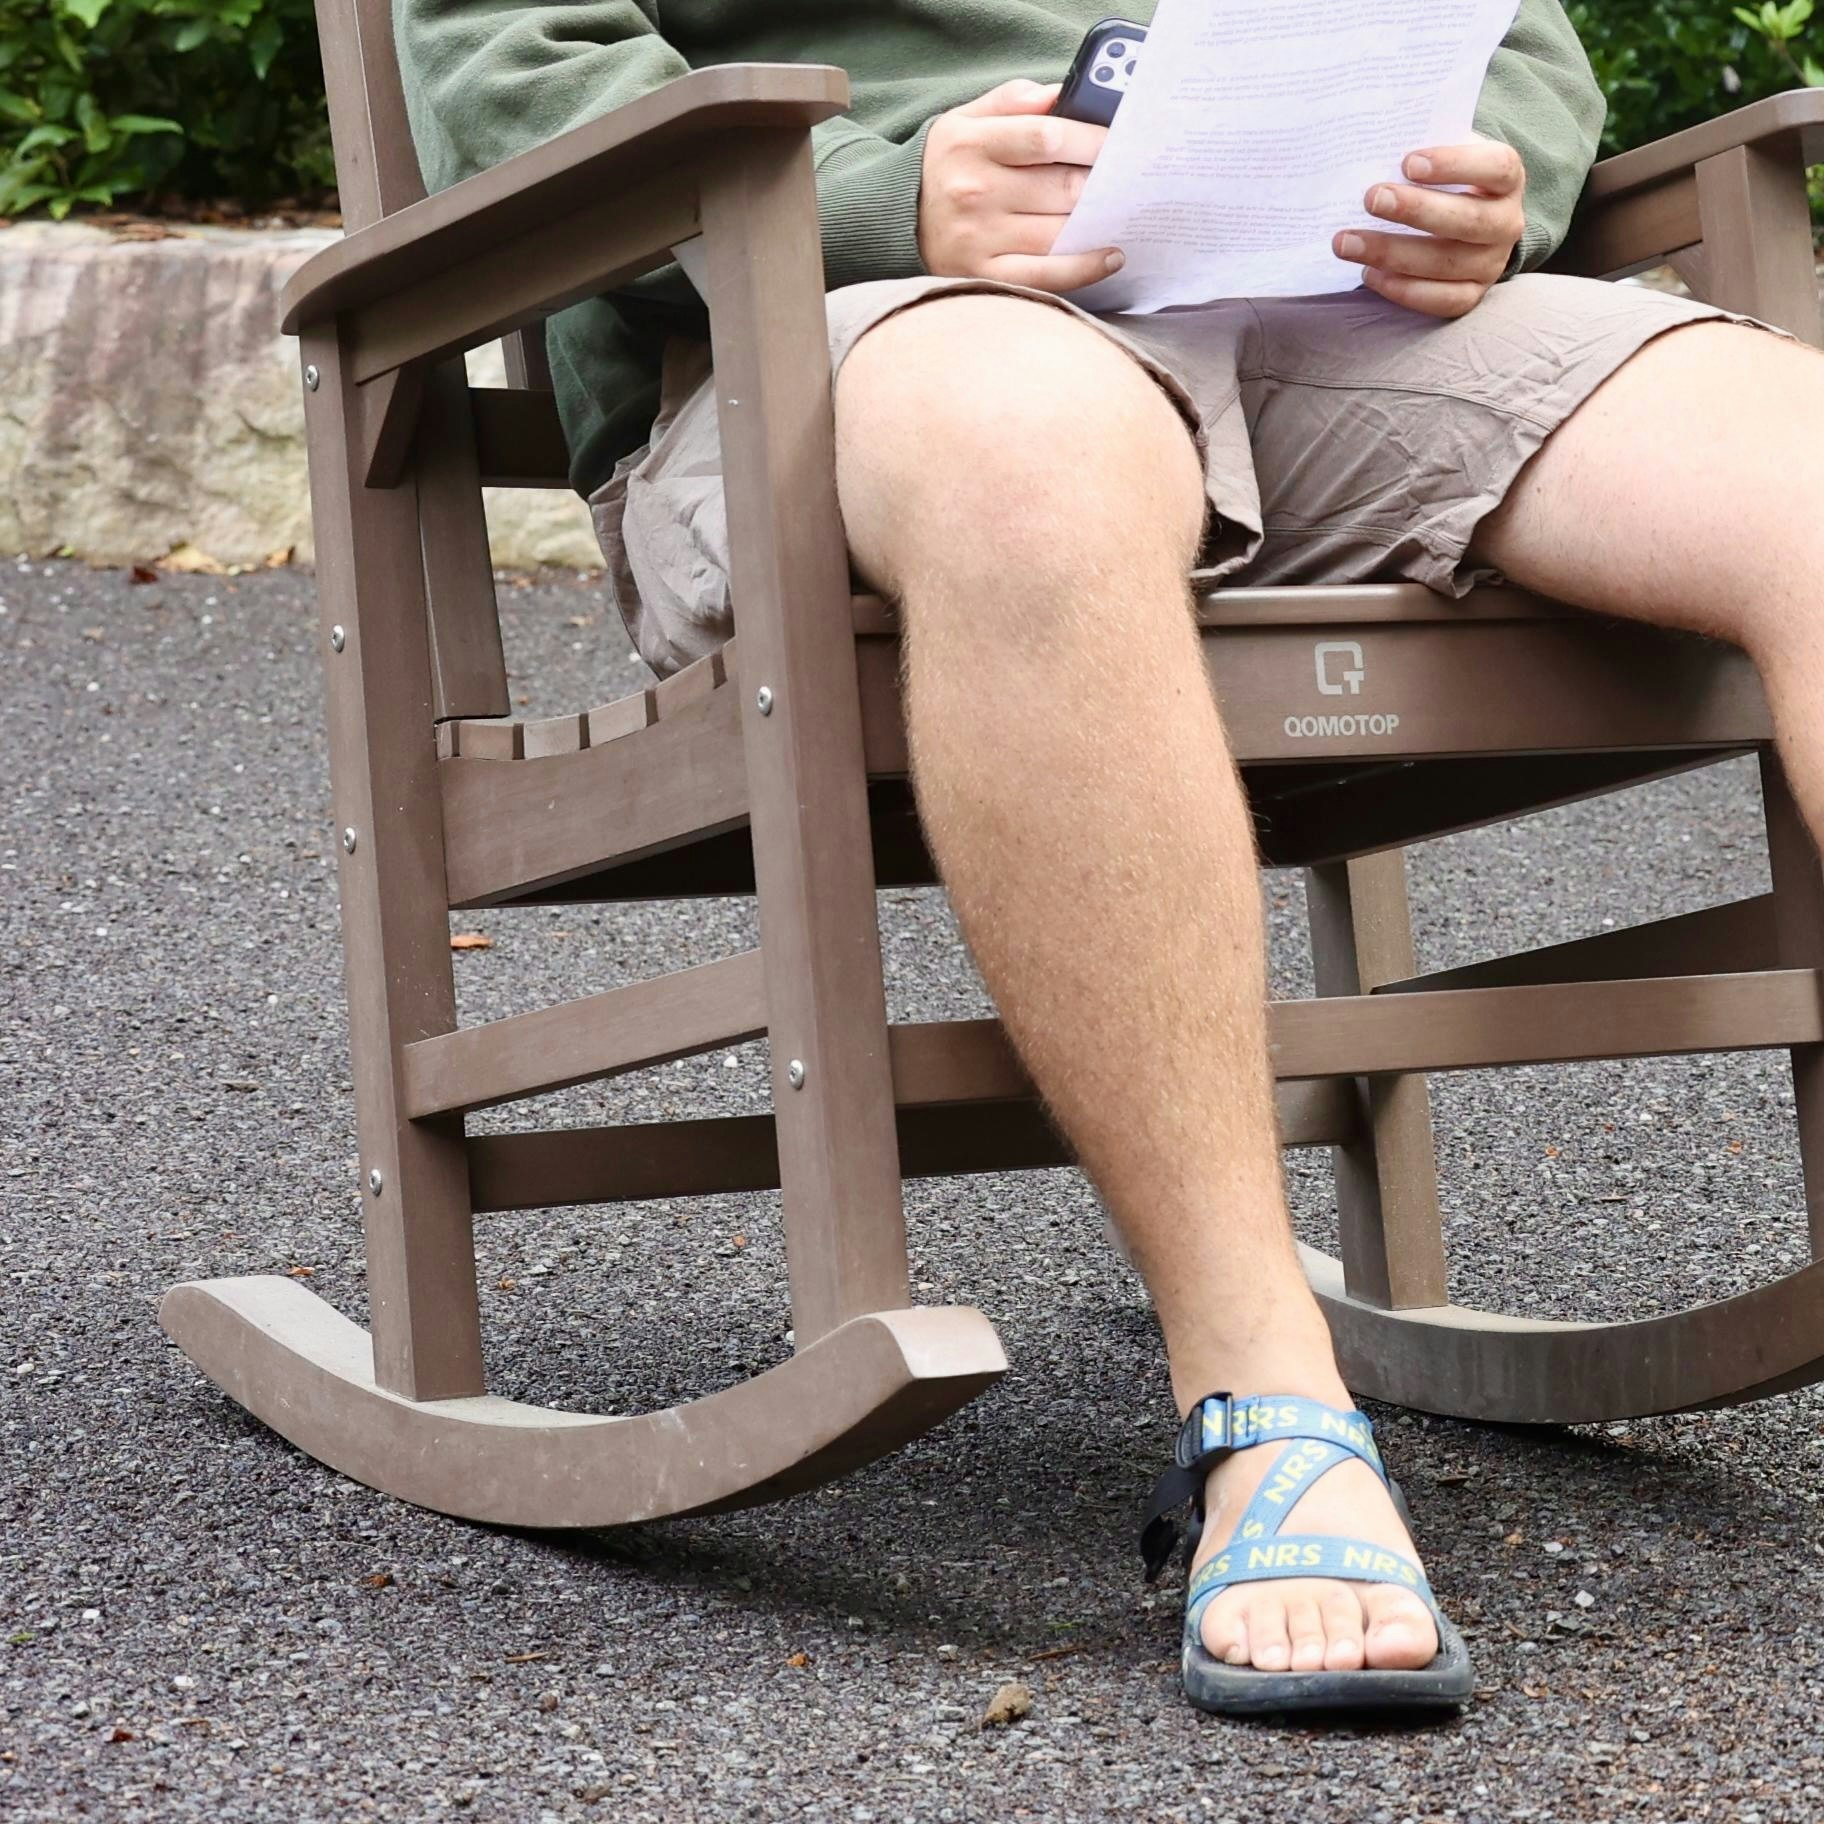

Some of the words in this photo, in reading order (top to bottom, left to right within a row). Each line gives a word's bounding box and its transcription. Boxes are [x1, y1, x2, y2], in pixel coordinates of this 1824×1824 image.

[1283, 713, 1400, 738] QOMOTOP
[1263, 1440, 1328, 1505] NRS
[1247, 1543, 1323, 1570] NRS
[1343, 1545, 1418, 1586] NRS
